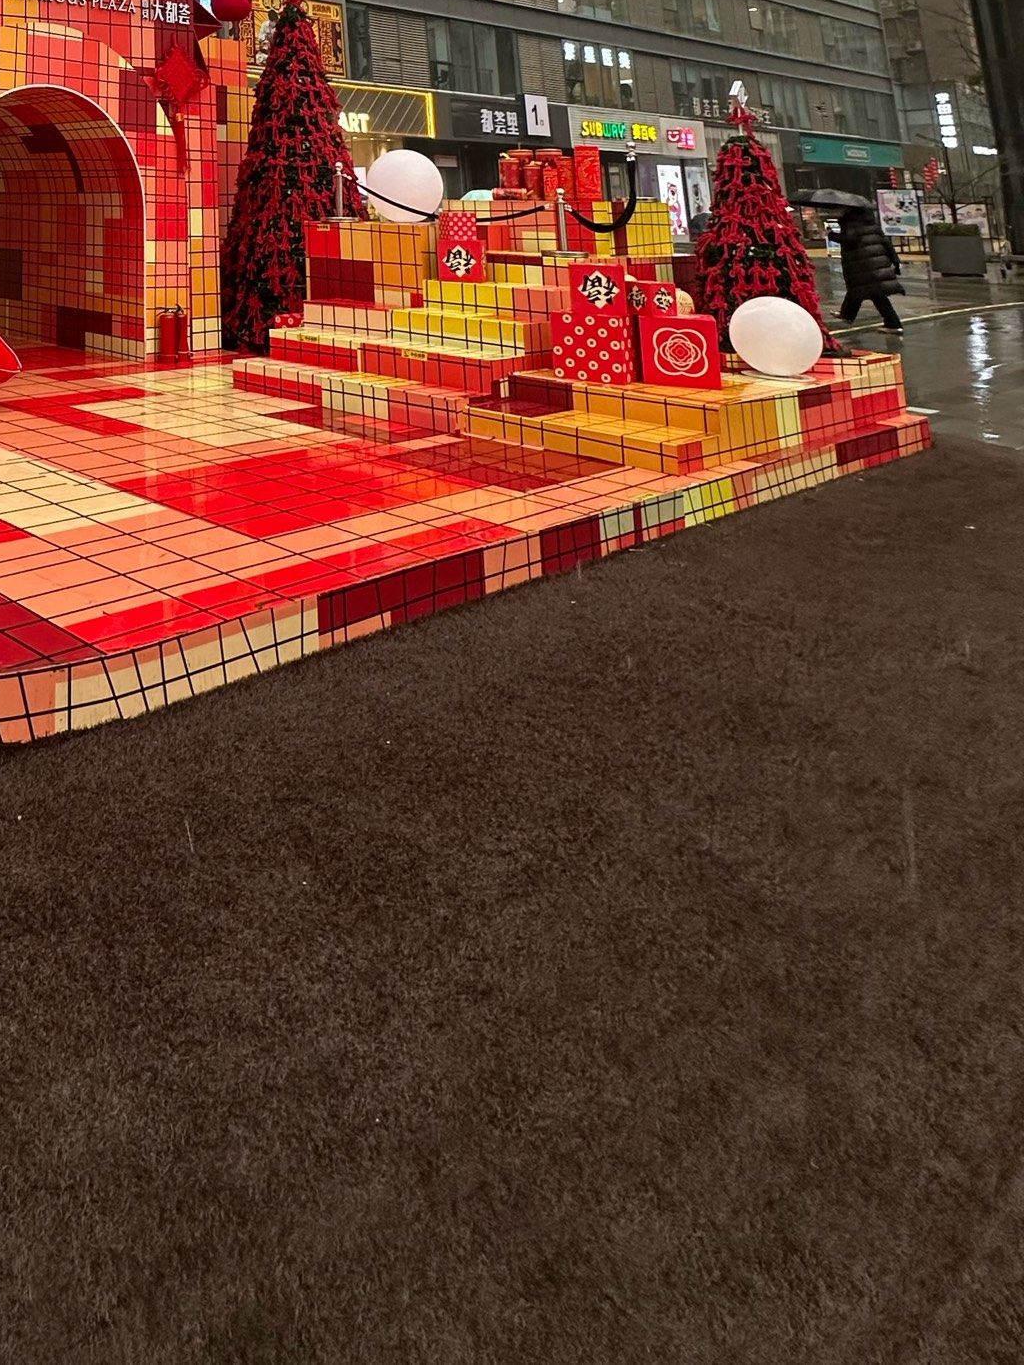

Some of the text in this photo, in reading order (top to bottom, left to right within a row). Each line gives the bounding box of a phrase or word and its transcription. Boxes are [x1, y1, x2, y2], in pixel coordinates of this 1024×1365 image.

[153, 0, 191, 26] 大都荟
[581, 120, 626, 139] SUBWAY
[631, 123, 657, 142] 赛百味
